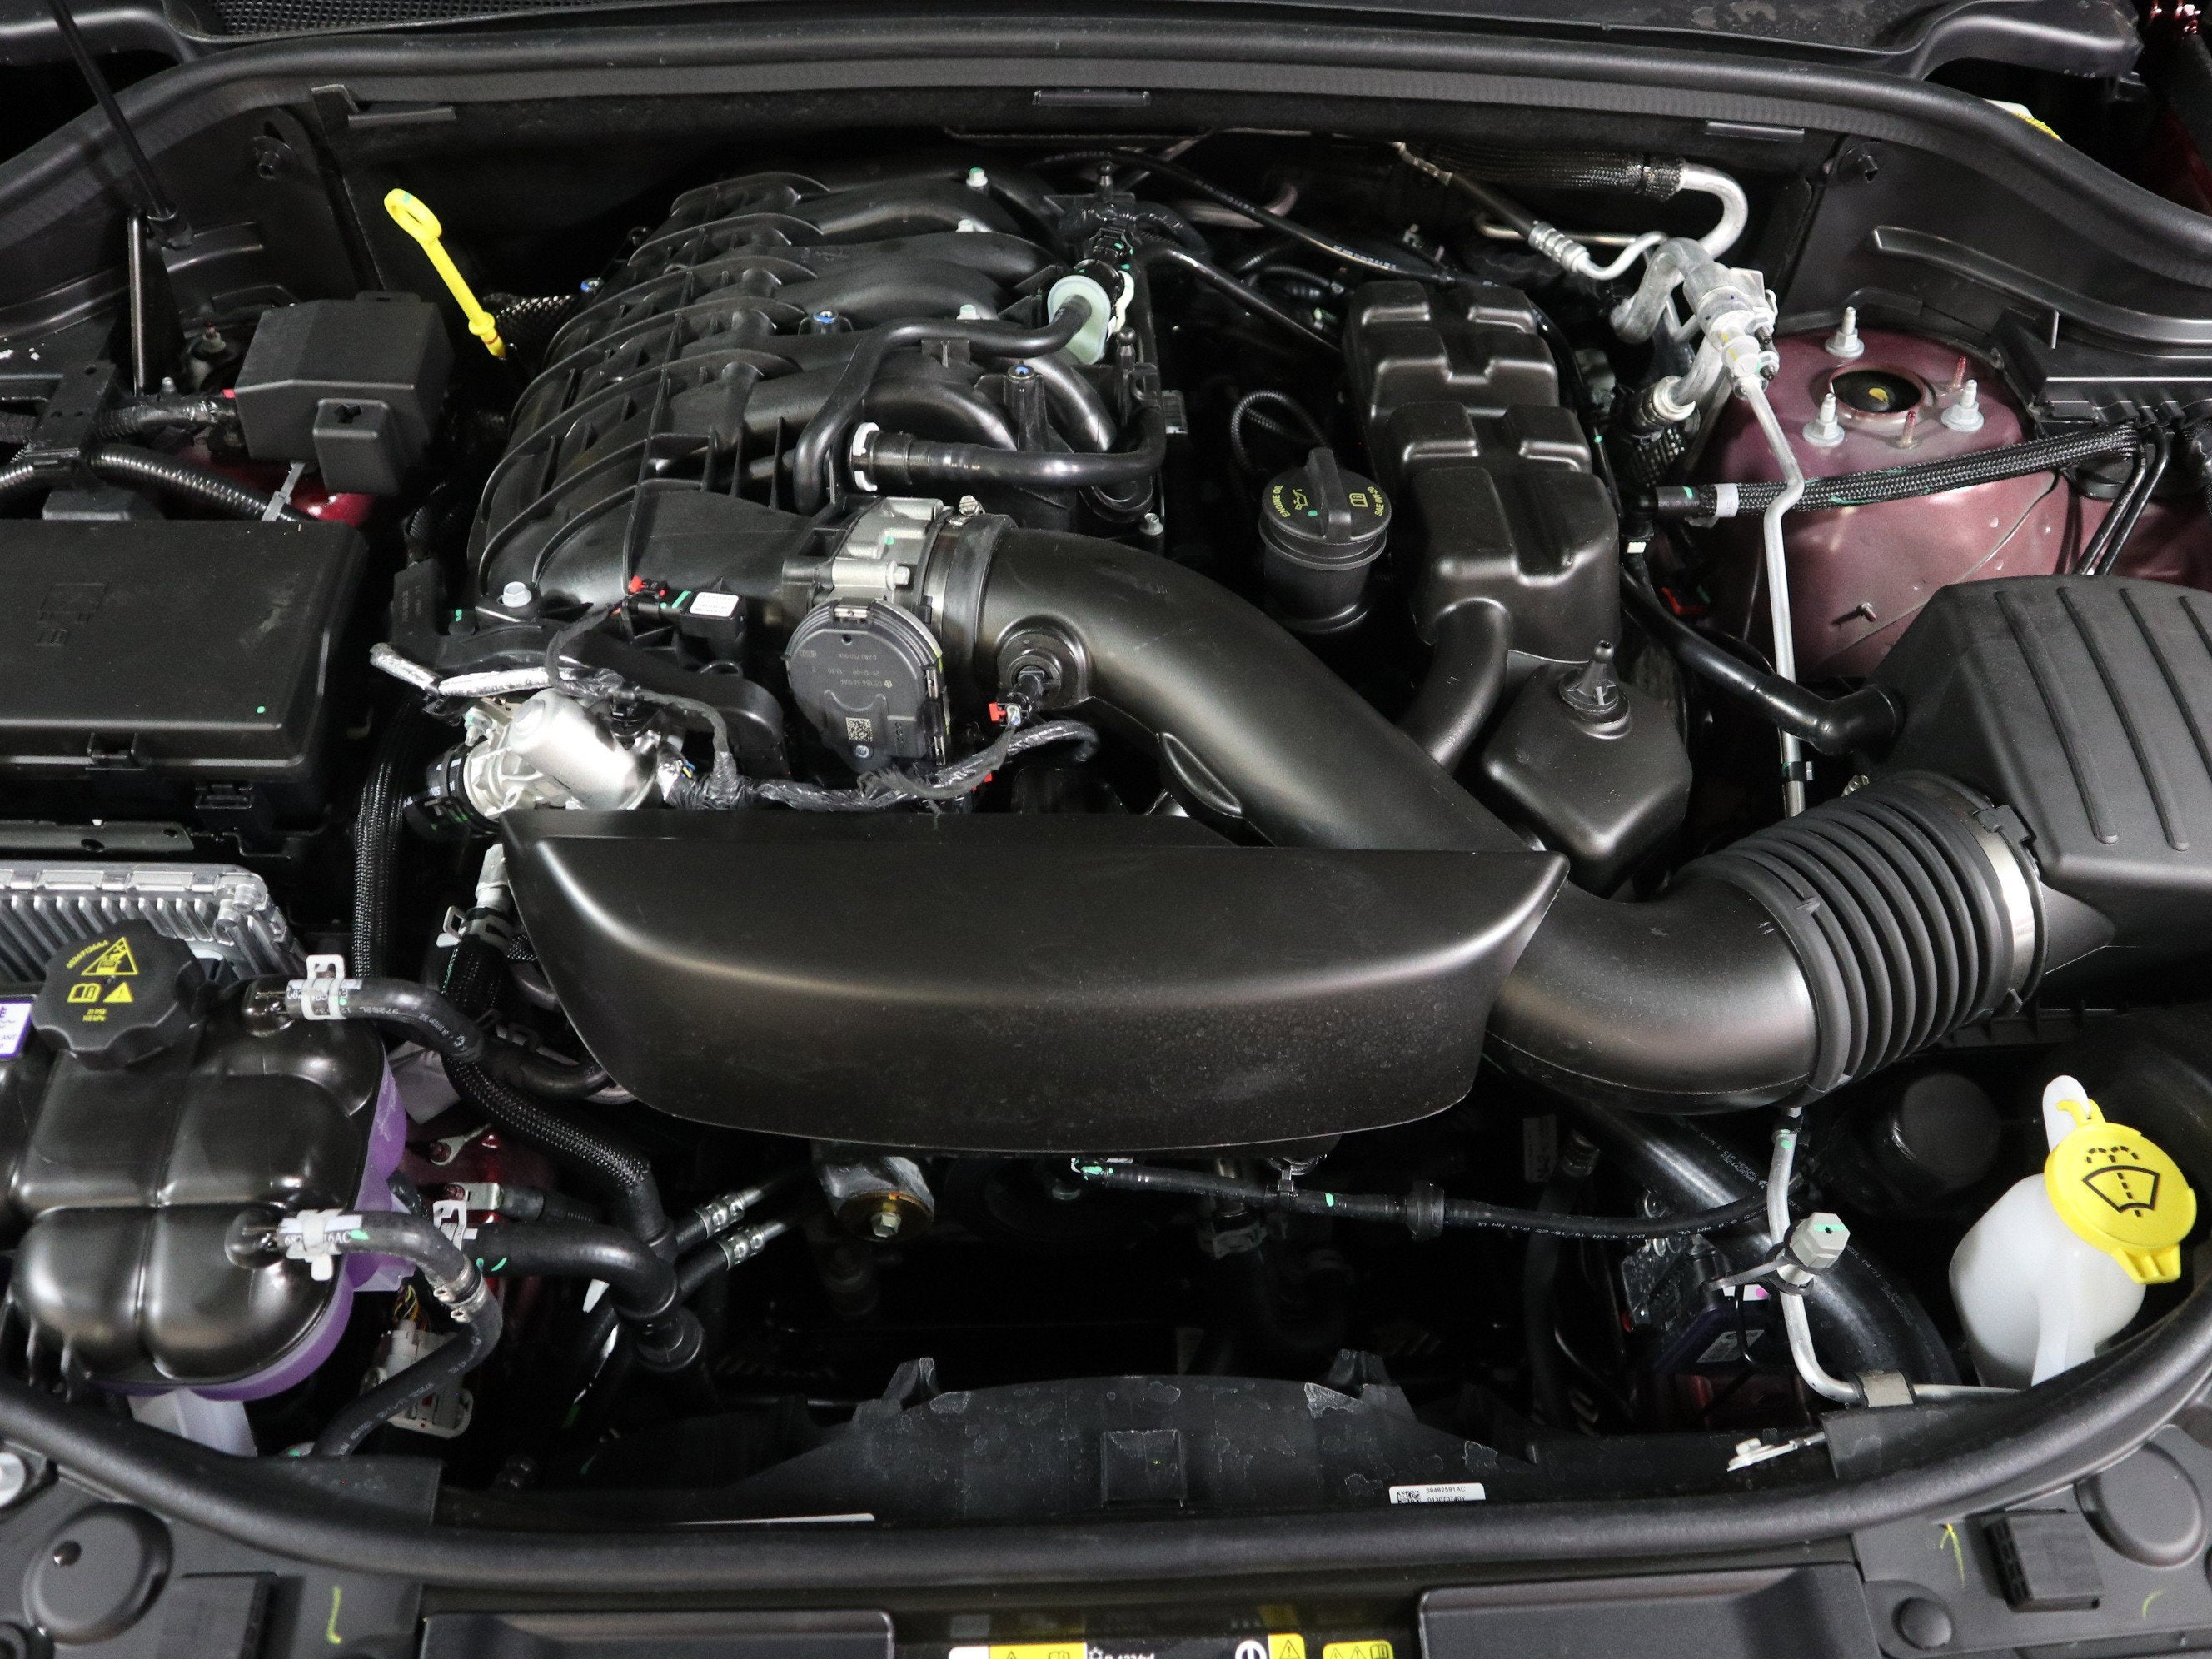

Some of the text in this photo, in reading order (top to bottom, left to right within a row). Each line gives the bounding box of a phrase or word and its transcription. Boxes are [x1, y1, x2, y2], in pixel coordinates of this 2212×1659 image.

[1272, 484, 1291, 518] ENGINE OIL
[1374, 502, 1385, 516] SAE
